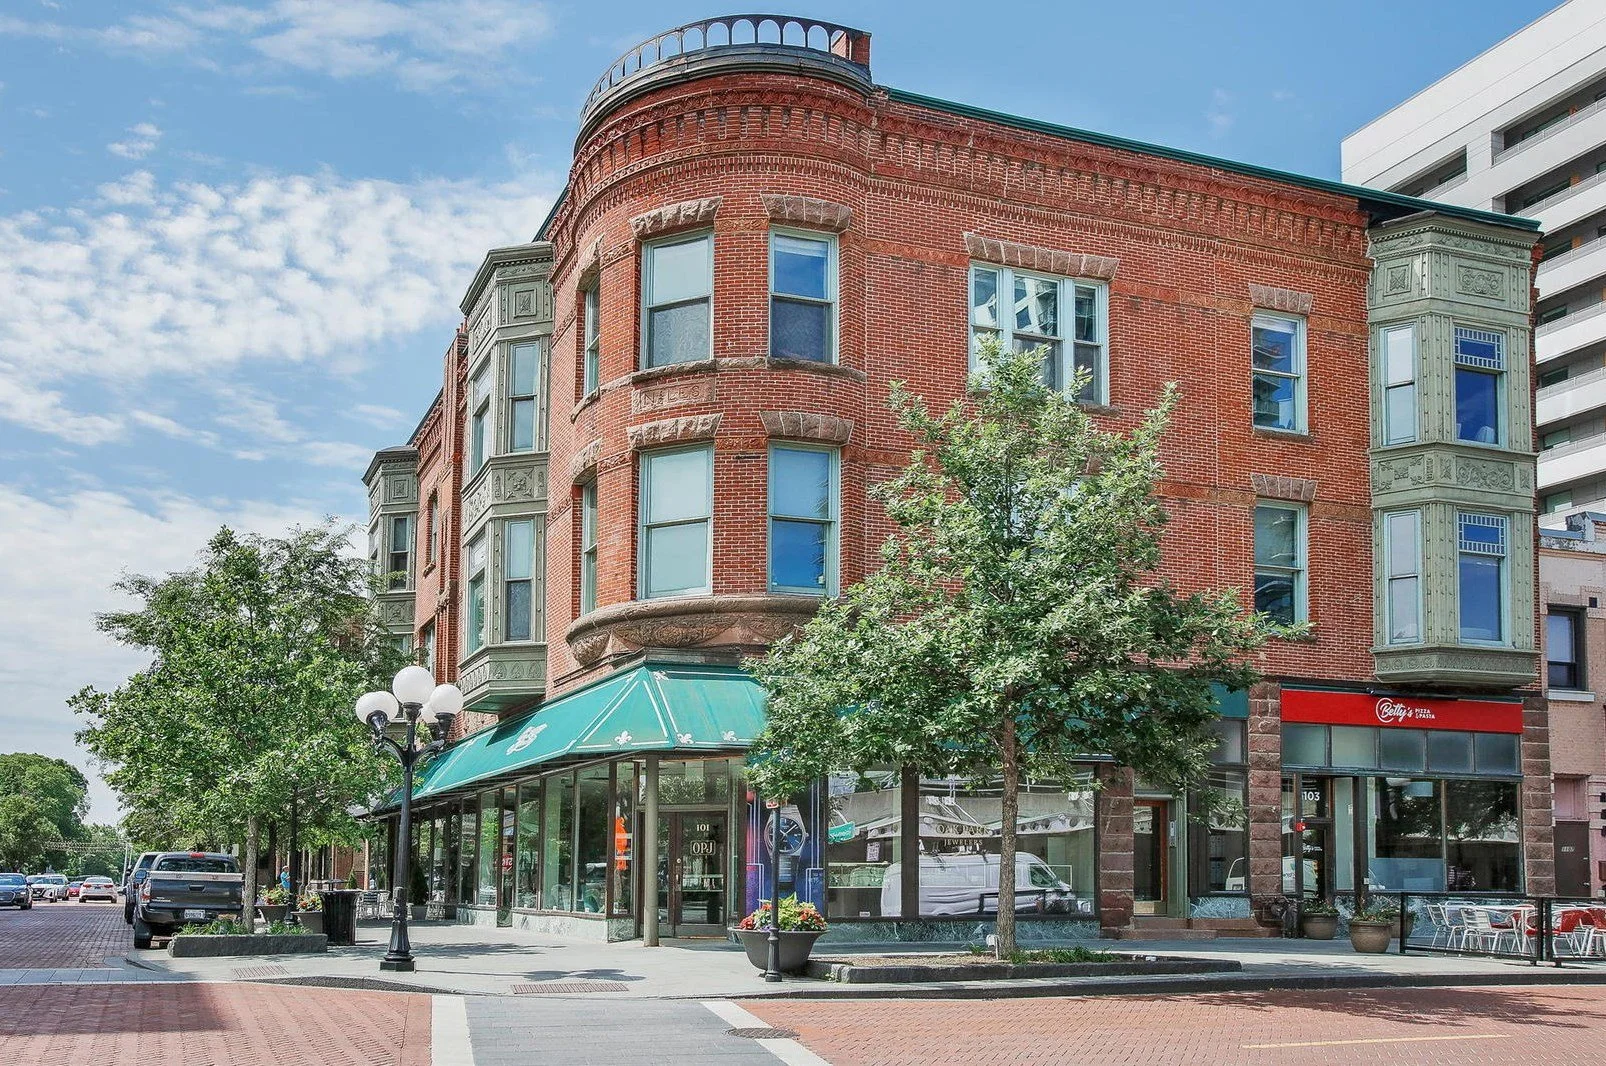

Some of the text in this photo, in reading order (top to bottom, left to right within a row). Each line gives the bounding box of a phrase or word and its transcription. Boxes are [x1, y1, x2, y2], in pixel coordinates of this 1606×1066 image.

[1377, 699, 1413, 722] Betty's
[935, 823, 990, 836] OAK PARK
[692, 842, 713, 854] OPJ
